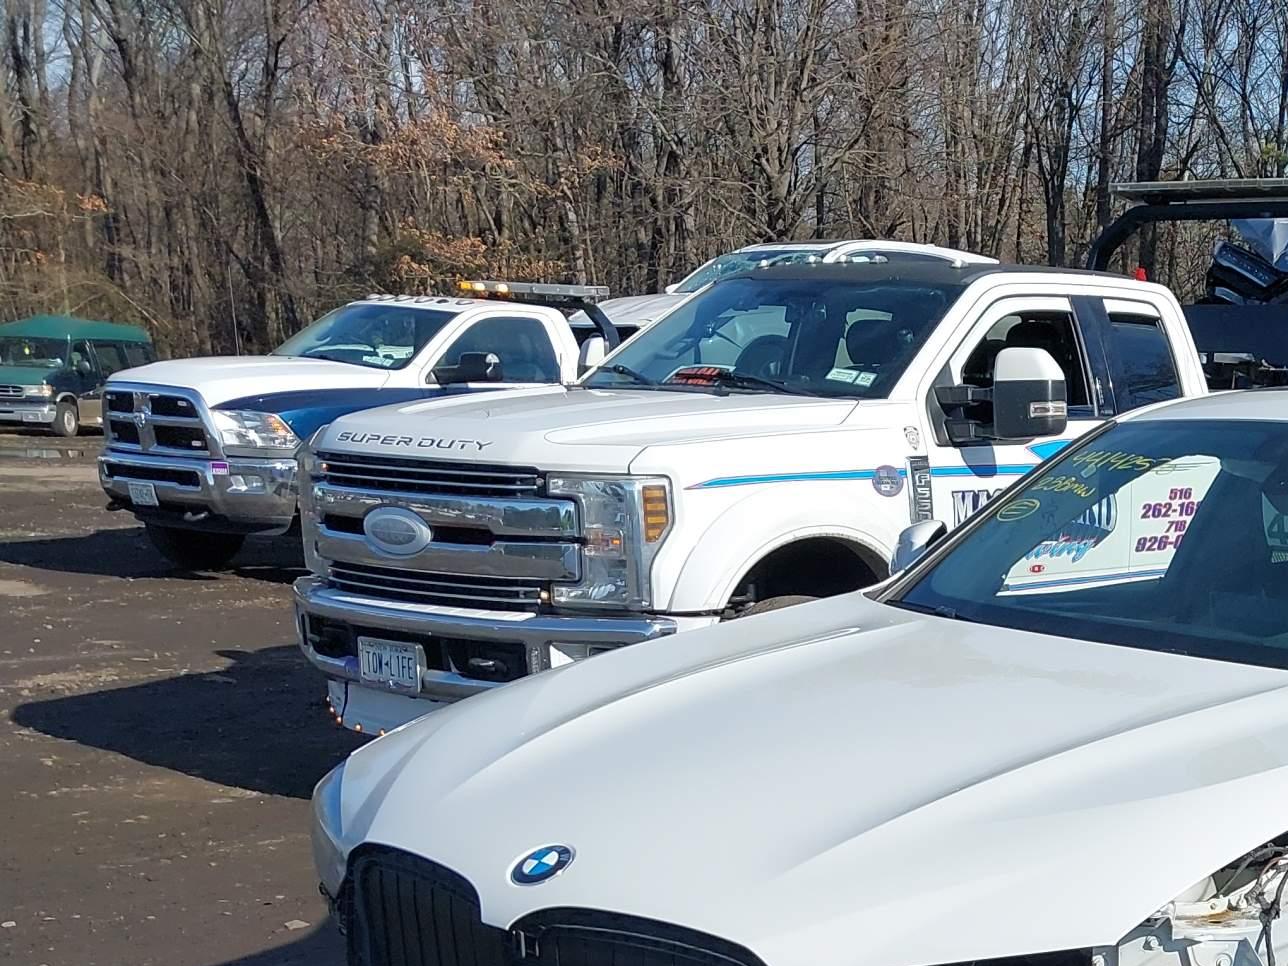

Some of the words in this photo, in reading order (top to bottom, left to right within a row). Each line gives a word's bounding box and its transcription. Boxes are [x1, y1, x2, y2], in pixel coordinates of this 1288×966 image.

[337, 431, 413, 447] SUPER
[416, 437, 494, 451] DUTY
[1168, 487, 1193, 500] 516
[1140, 501, 1202, 519] 262-16
[1164, 520, 1187, 534] 718
